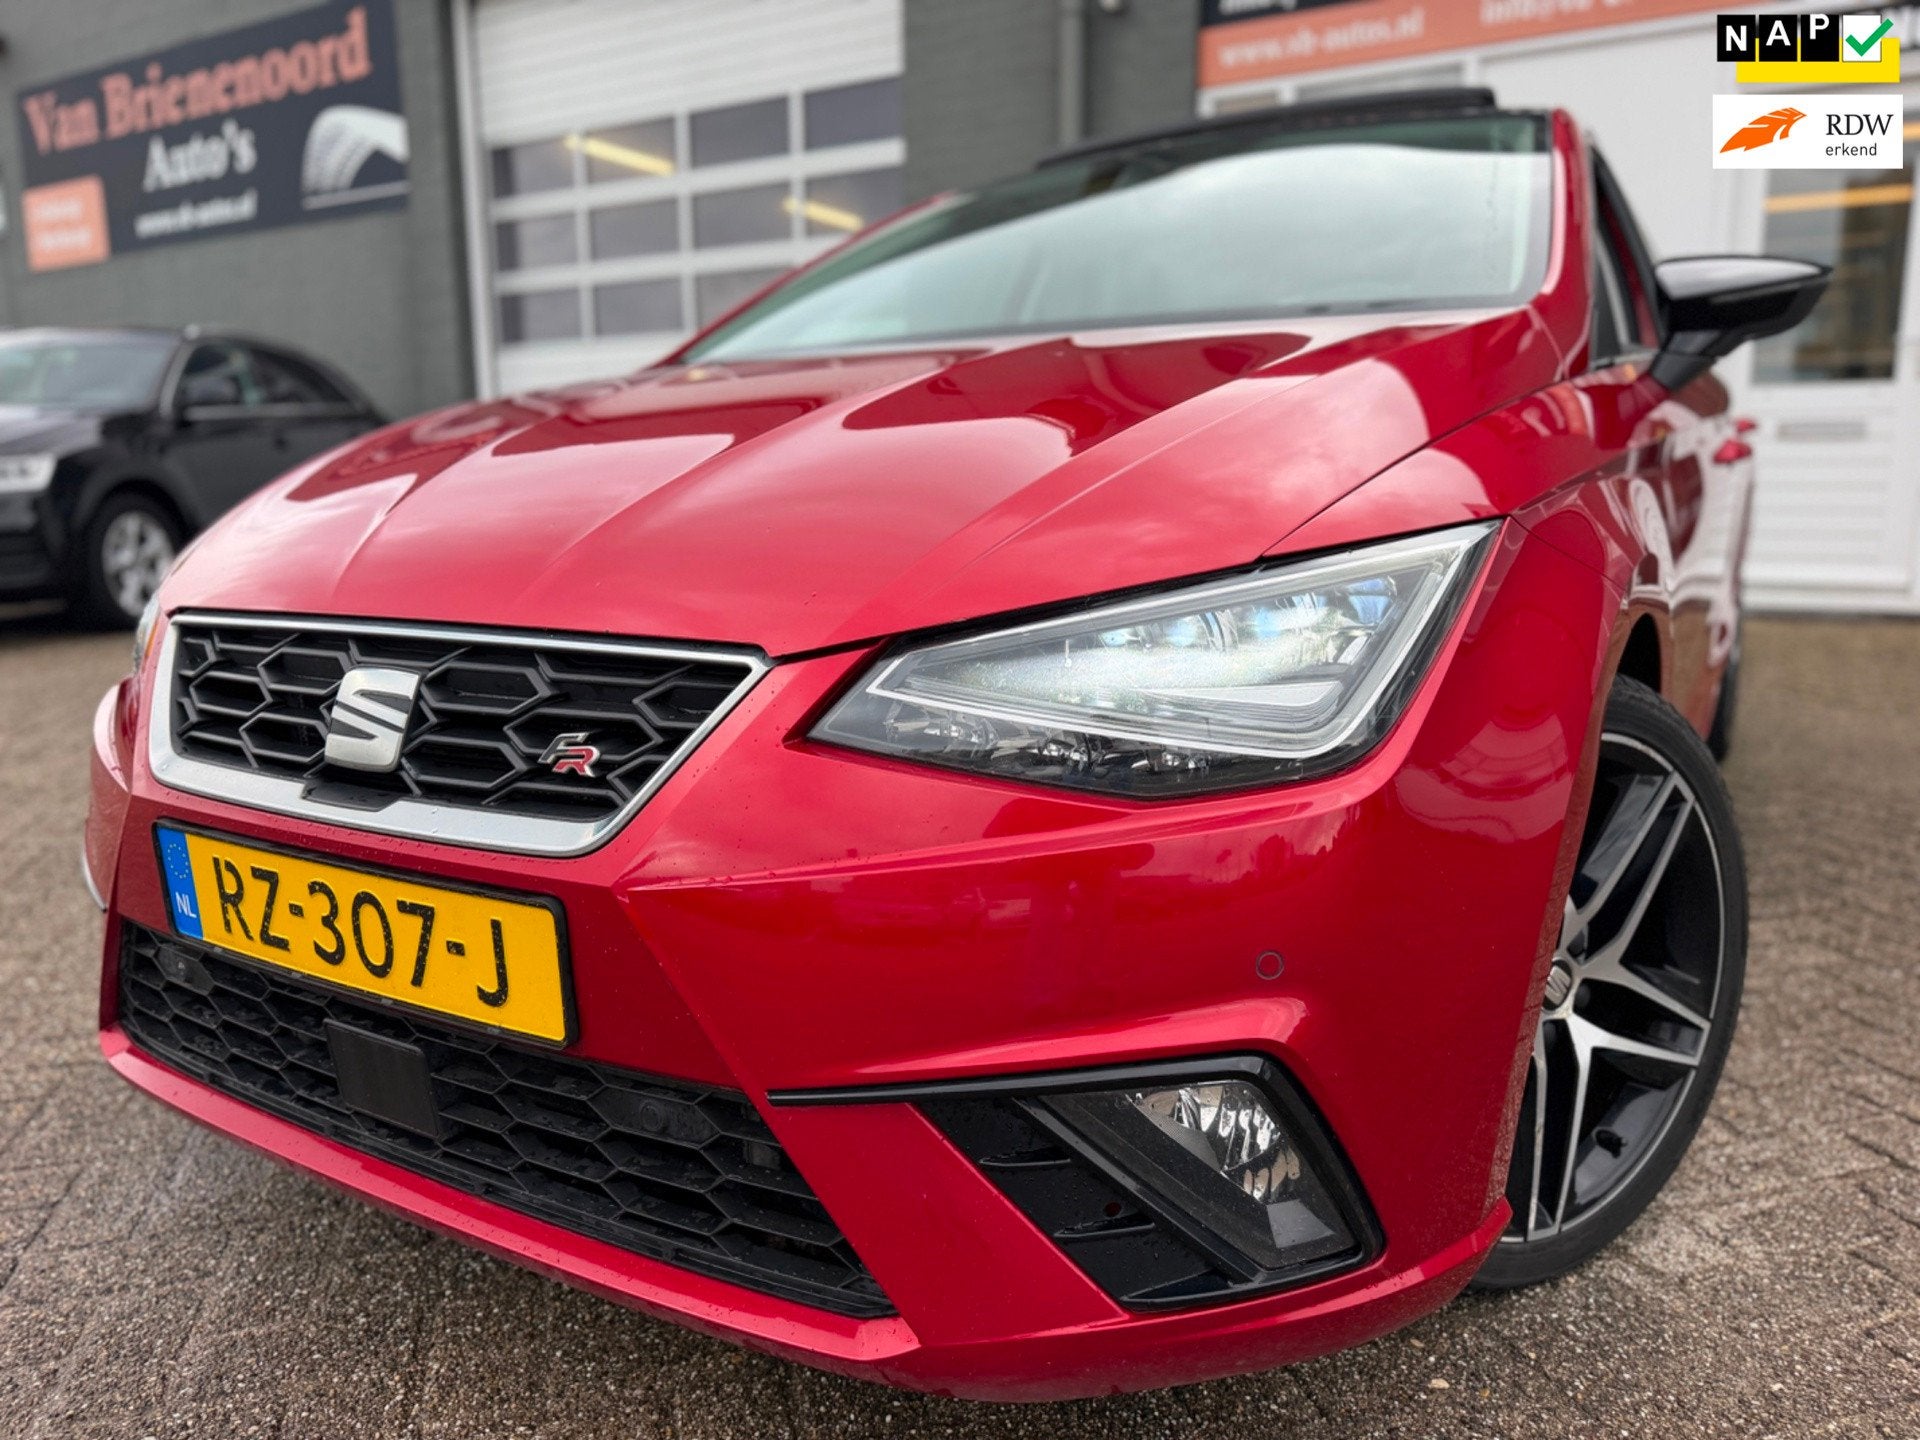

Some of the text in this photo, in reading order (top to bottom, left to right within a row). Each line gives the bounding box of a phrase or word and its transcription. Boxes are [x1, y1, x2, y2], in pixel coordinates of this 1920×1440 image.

[24, 6, 372, 155] Van Brienenoord
[142, 118, 257, 193] Auto's
[175, 892, 197, 919] NL
[213, 856, 509, 1007] RZ-307-J
